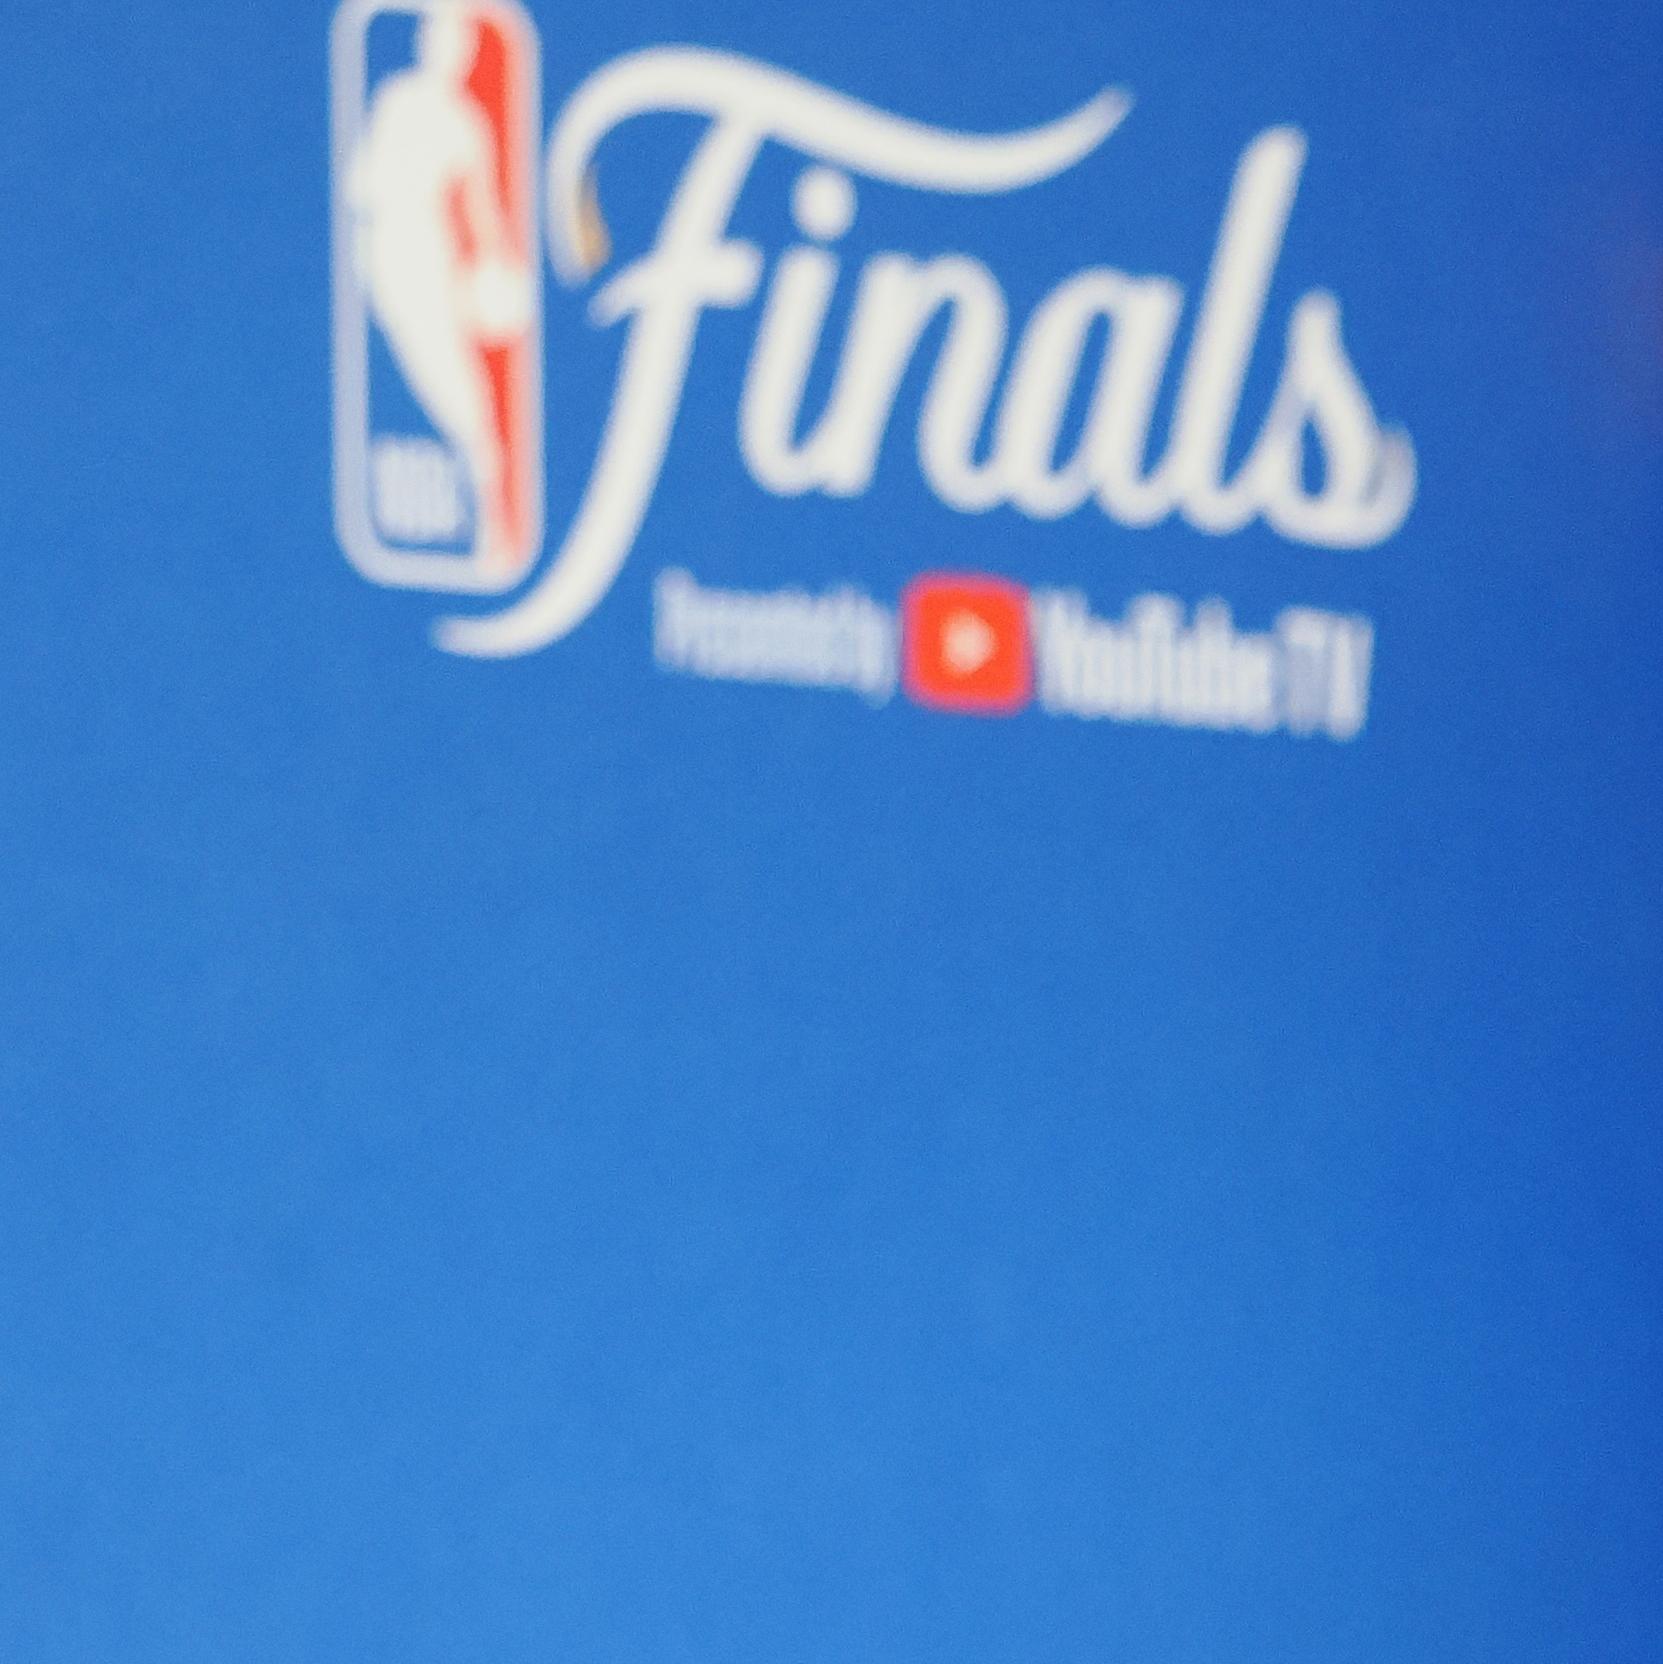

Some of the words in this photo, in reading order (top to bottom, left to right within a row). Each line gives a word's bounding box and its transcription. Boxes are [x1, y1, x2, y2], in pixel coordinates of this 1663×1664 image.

[431, 42, 1416, 659] Finals
[1031, 585, 1277, 736] YouTube
[1276, 603, 1376, 744] TV
